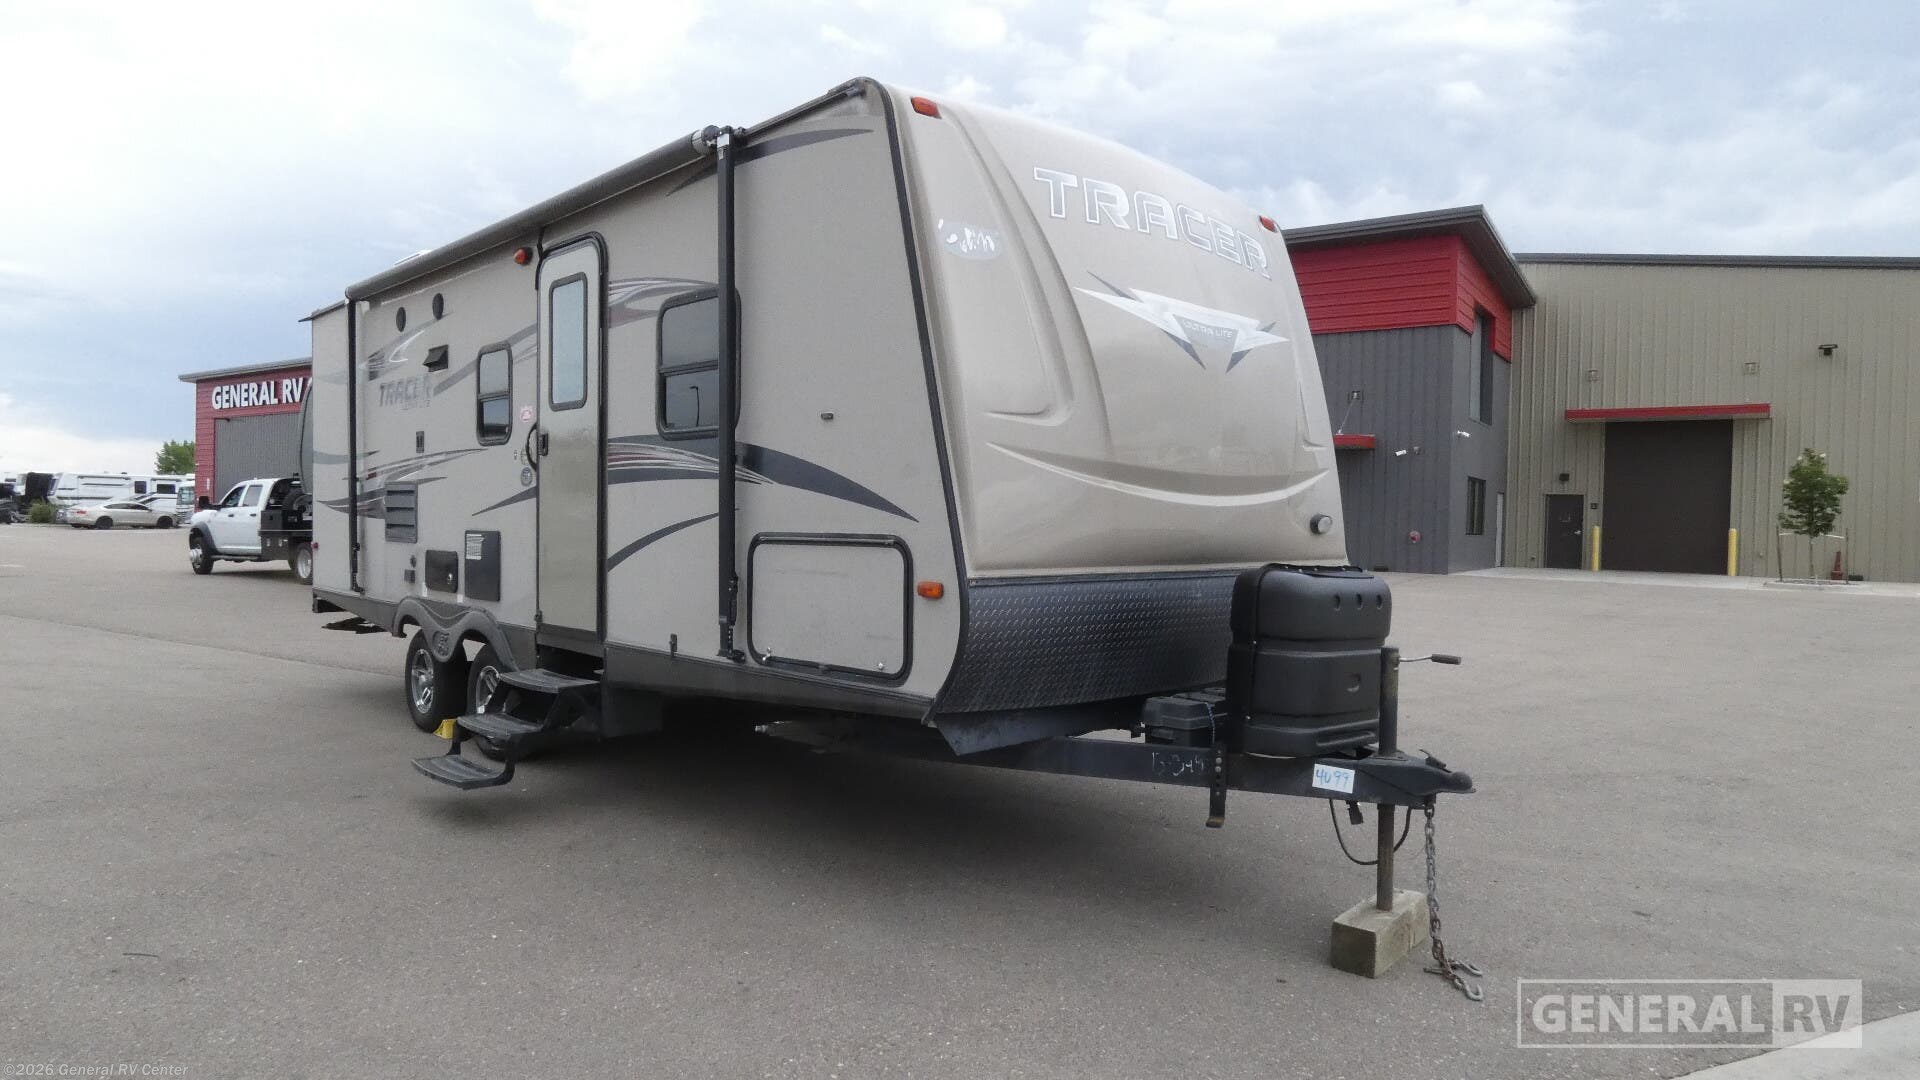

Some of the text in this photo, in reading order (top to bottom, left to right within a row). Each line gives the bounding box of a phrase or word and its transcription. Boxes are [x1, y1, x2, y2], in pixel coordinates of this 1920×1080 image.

[1033, 167, 1273, 281] TRACER
[212, 381, 278, 410] GENERAL
[282, 377, 304, 404] RV
